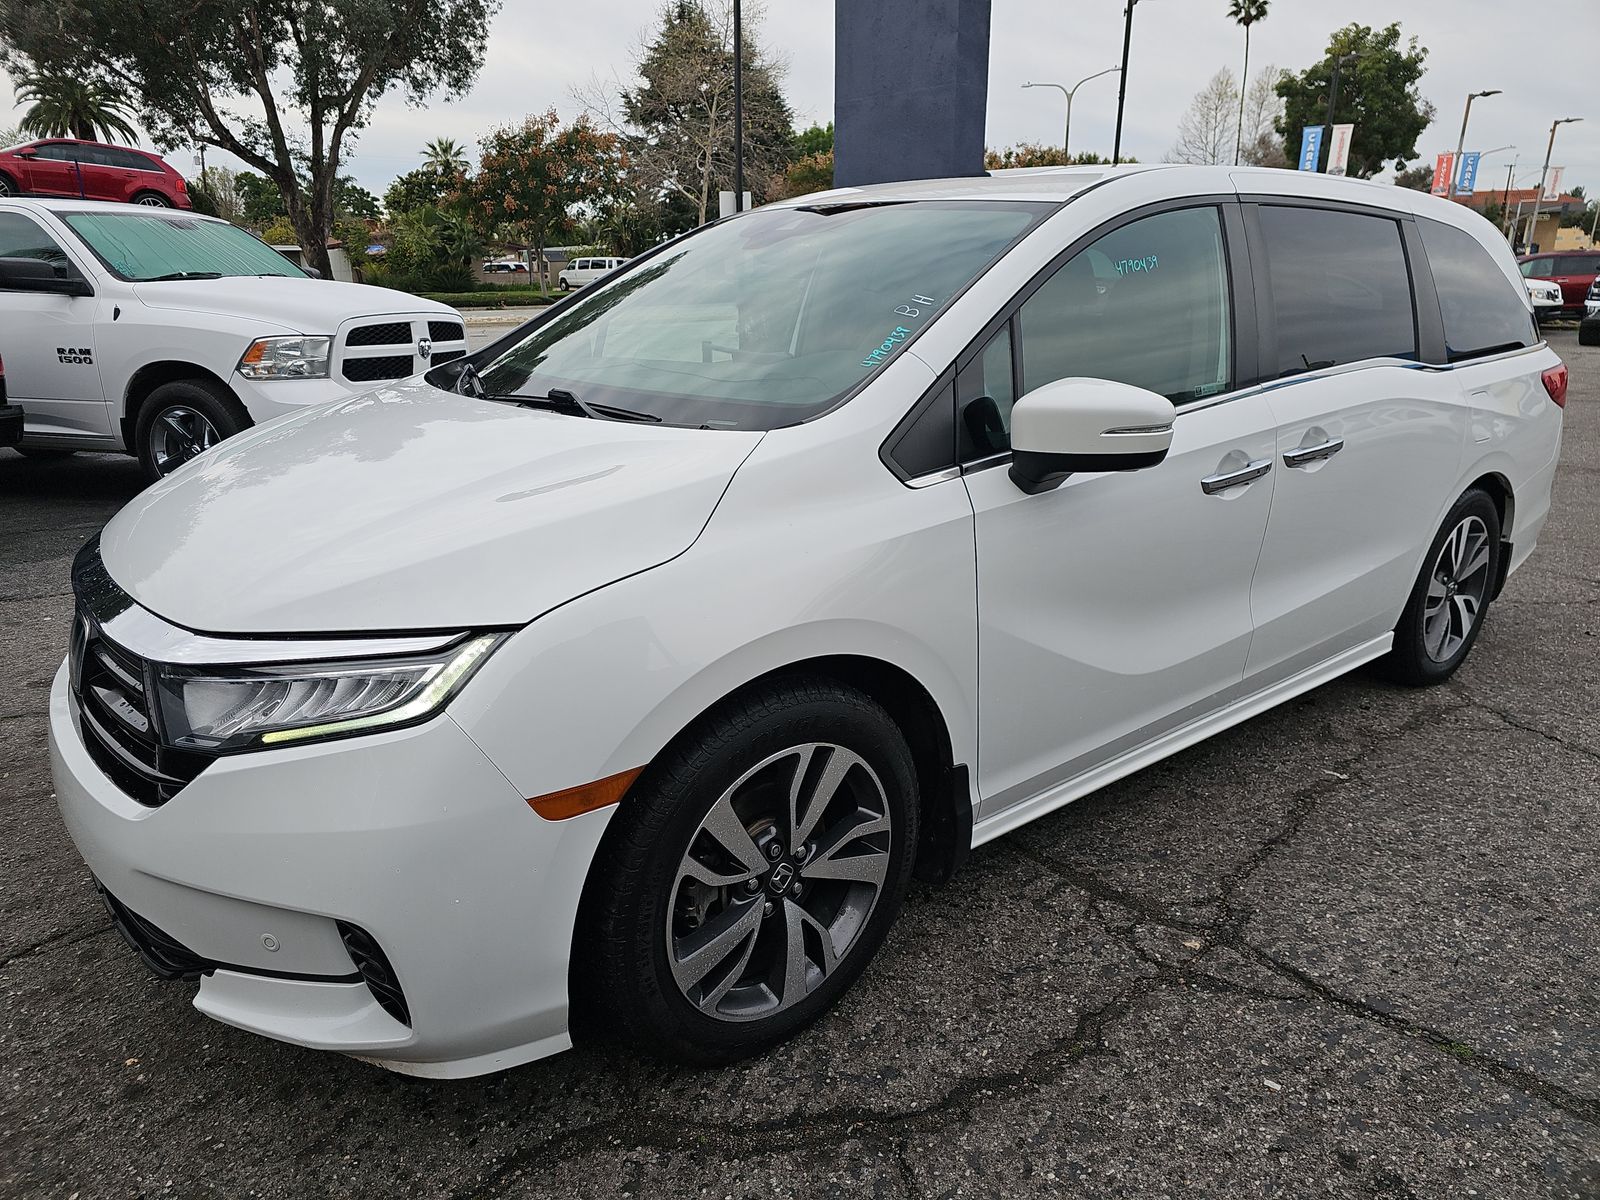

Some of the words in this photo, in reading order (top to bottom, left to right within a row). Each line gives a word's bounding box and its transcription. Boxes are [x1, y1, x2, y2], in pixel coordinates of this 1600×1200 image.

[1304, 133, 1316, 170] CARS
[1463, 157, 1474, 187] CARS
[1114, 254, 1159, 276] 4790439
[56, 347, 91, 356] RAM
[860, 326, 911, 367] 4790439
[58, 356, 93, 364] 1500
